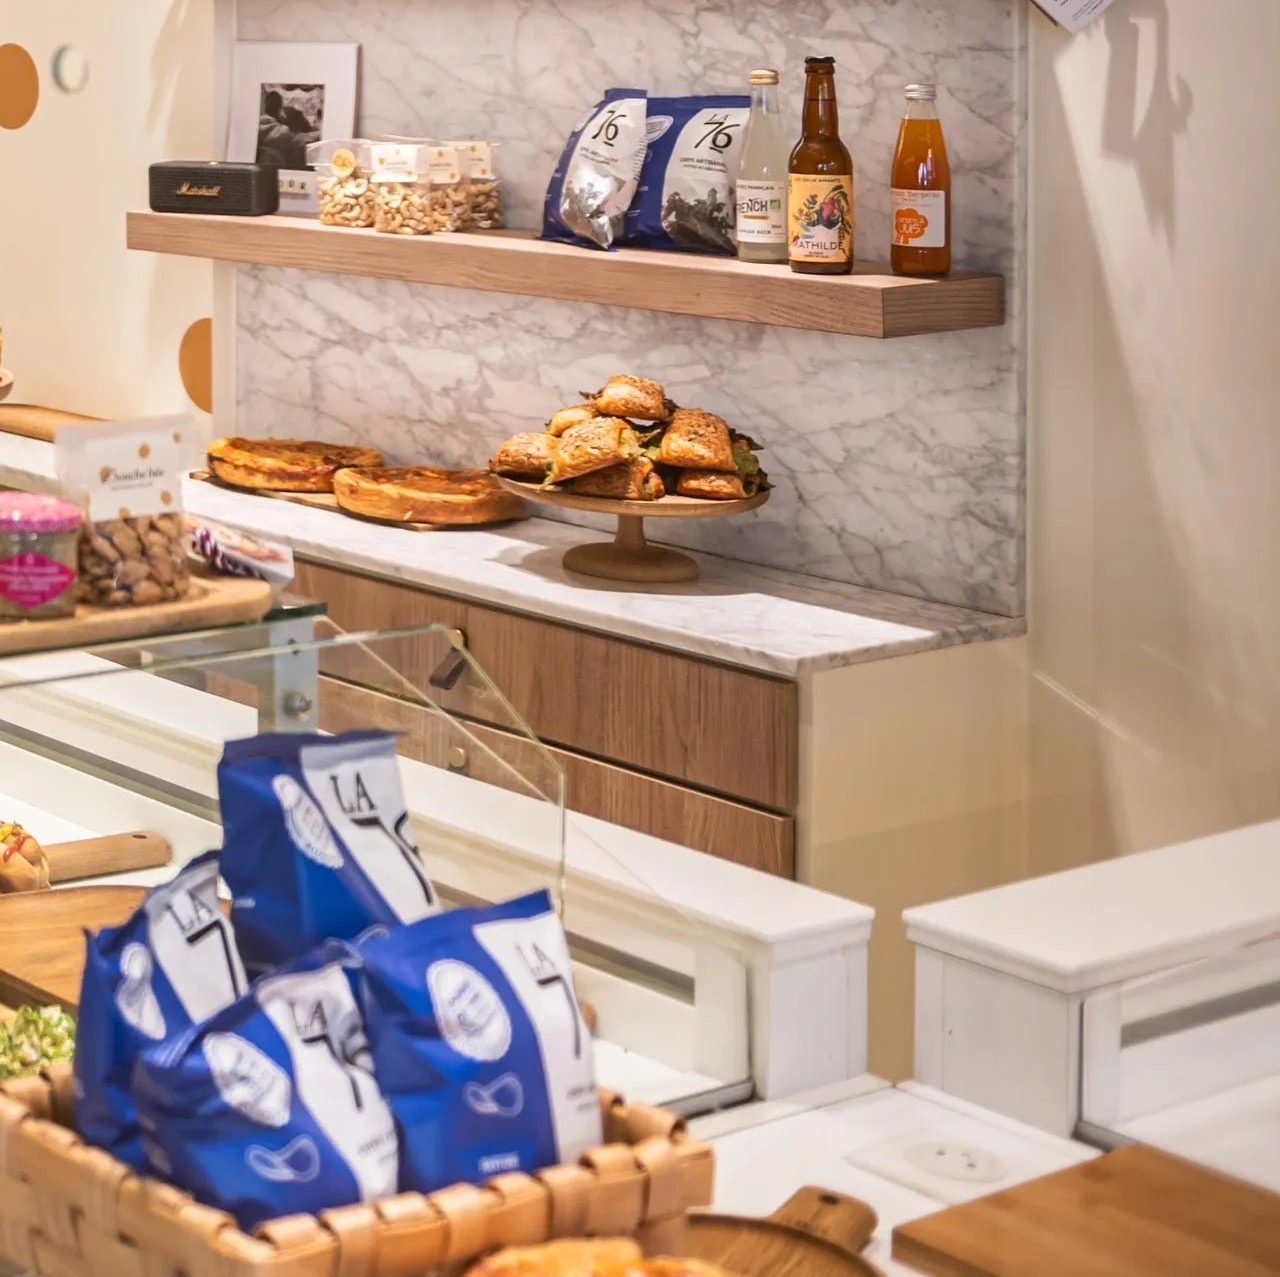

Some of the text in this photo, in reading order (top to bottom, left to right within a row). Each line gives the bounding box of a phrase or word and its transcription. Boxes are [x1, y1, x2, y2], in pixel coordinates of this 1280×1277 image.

[591, 110, 627, 143] 76
[694, 121, 740, 150] 76
[176, 182, 221, 196] Marshall
[330, 772, 378, 814] LA
[164, 892, 212, 935] LA
[516, 942, 557, 976] LA
